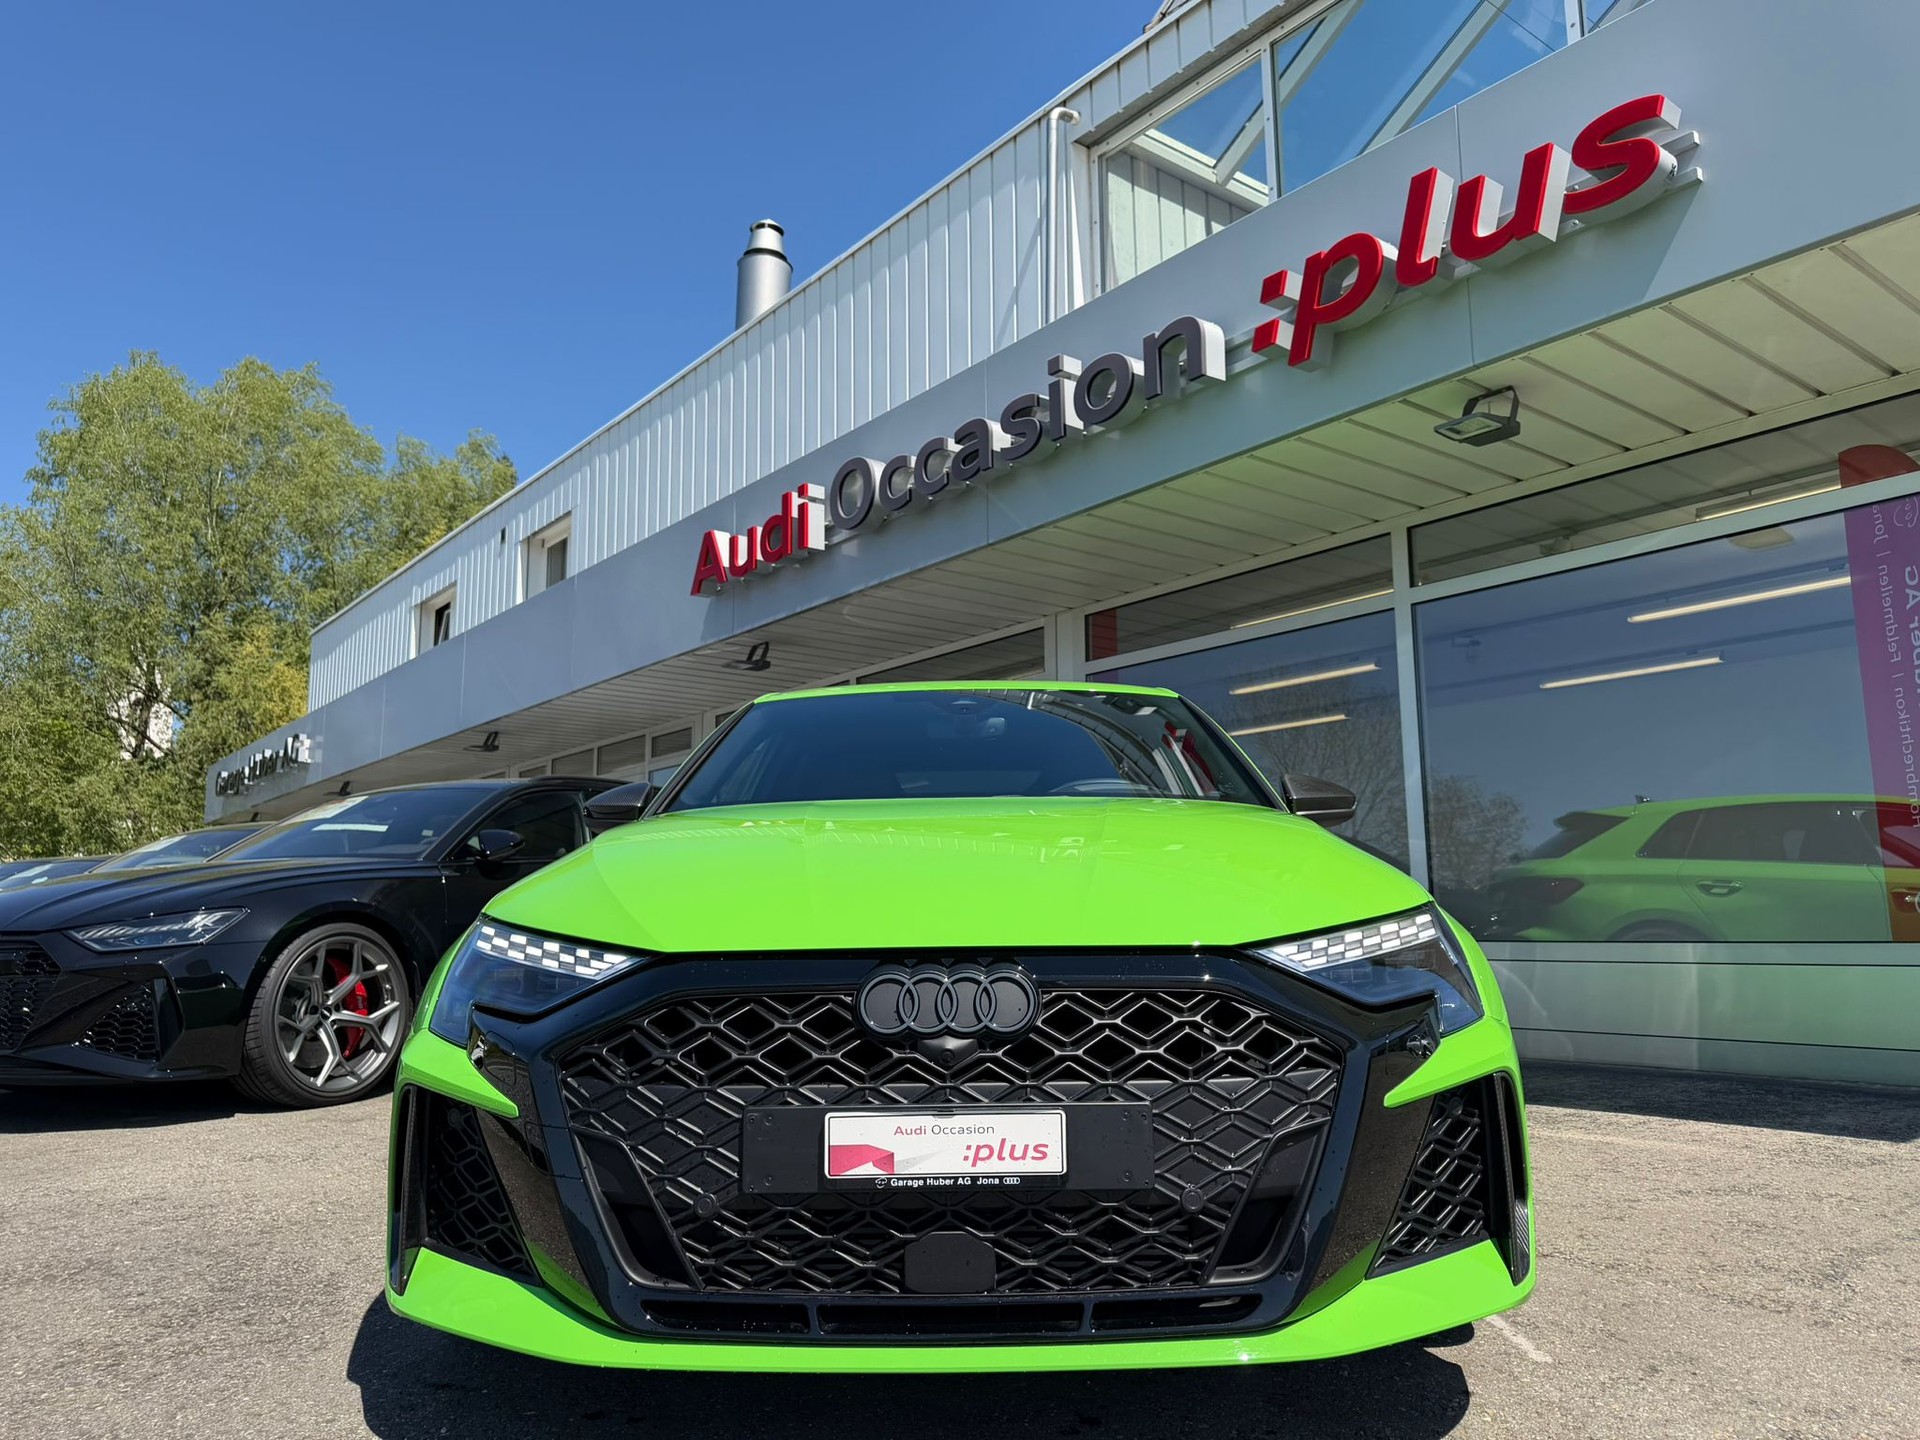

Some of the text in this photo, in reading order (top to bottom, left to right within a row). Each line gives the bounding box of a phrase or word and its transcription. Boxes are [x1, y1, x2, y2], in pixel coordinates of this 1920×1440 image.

[690, 482, 811, 597] Audi
[829, 315, 1208, 531] Occasion
[893, 1124, 995, 1136] Audi Occasion
[890, 1176, 1000, 1188] Garage Huber AG Jona
